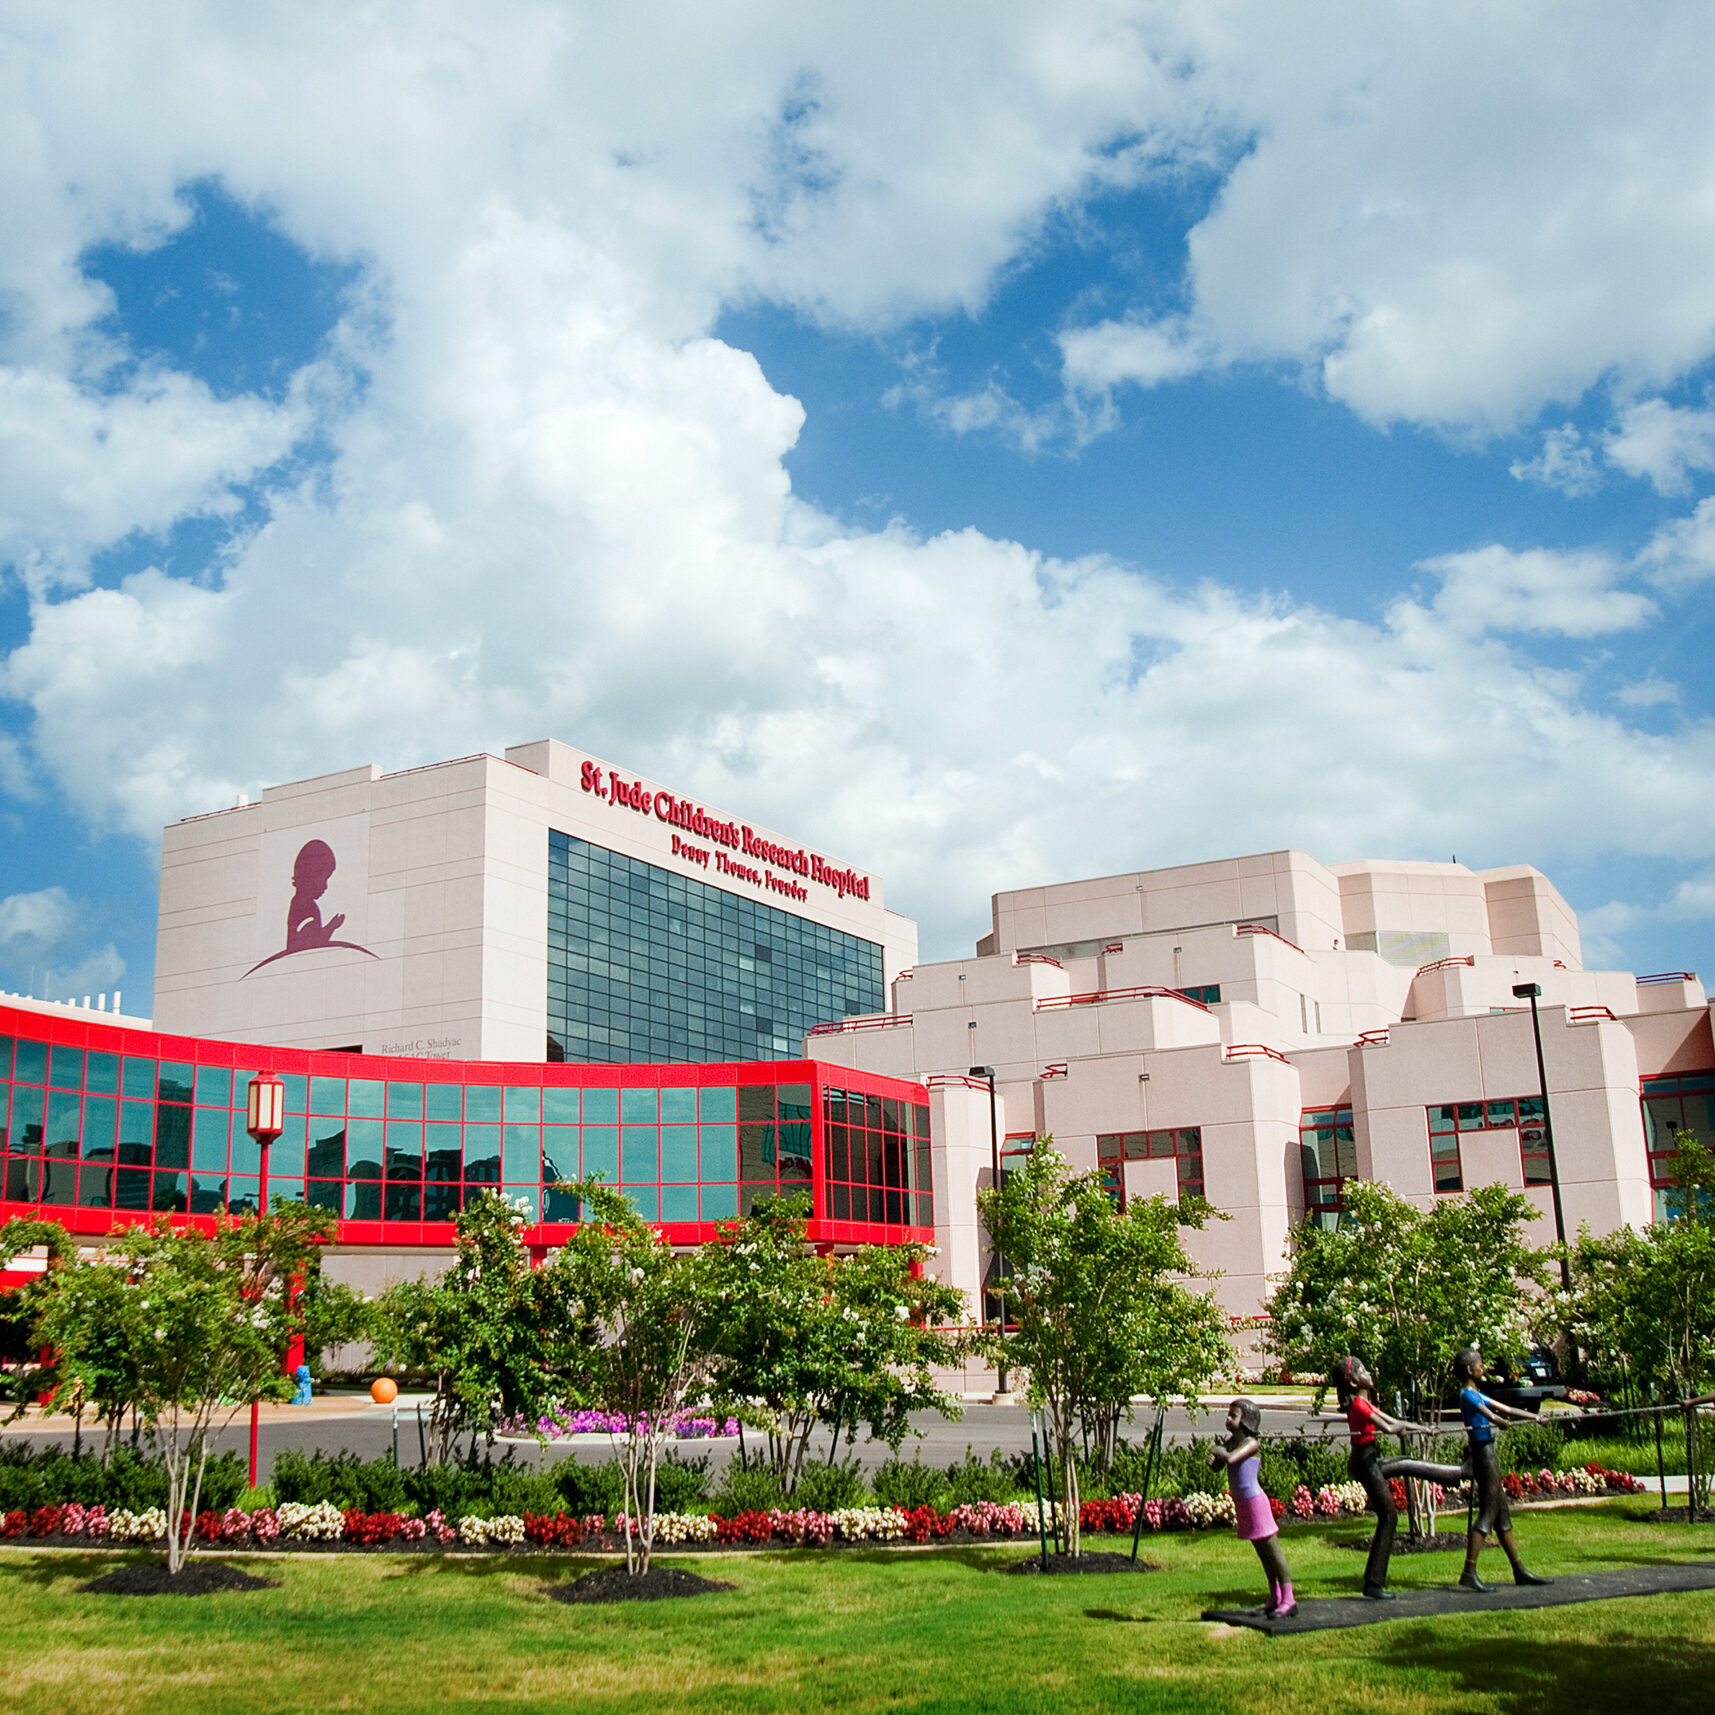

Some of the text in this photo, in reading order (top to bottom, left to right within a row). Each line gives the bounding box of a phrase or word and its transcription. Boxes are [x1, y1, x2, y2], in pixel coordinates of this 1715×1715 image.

[581, 761, 870, 901] St. Jude Children's Research Hospital
[672, 834, 808, 902] Danny Thomas, Founder
[382, 1037, 462, 1054] Richard C. Shadyac
